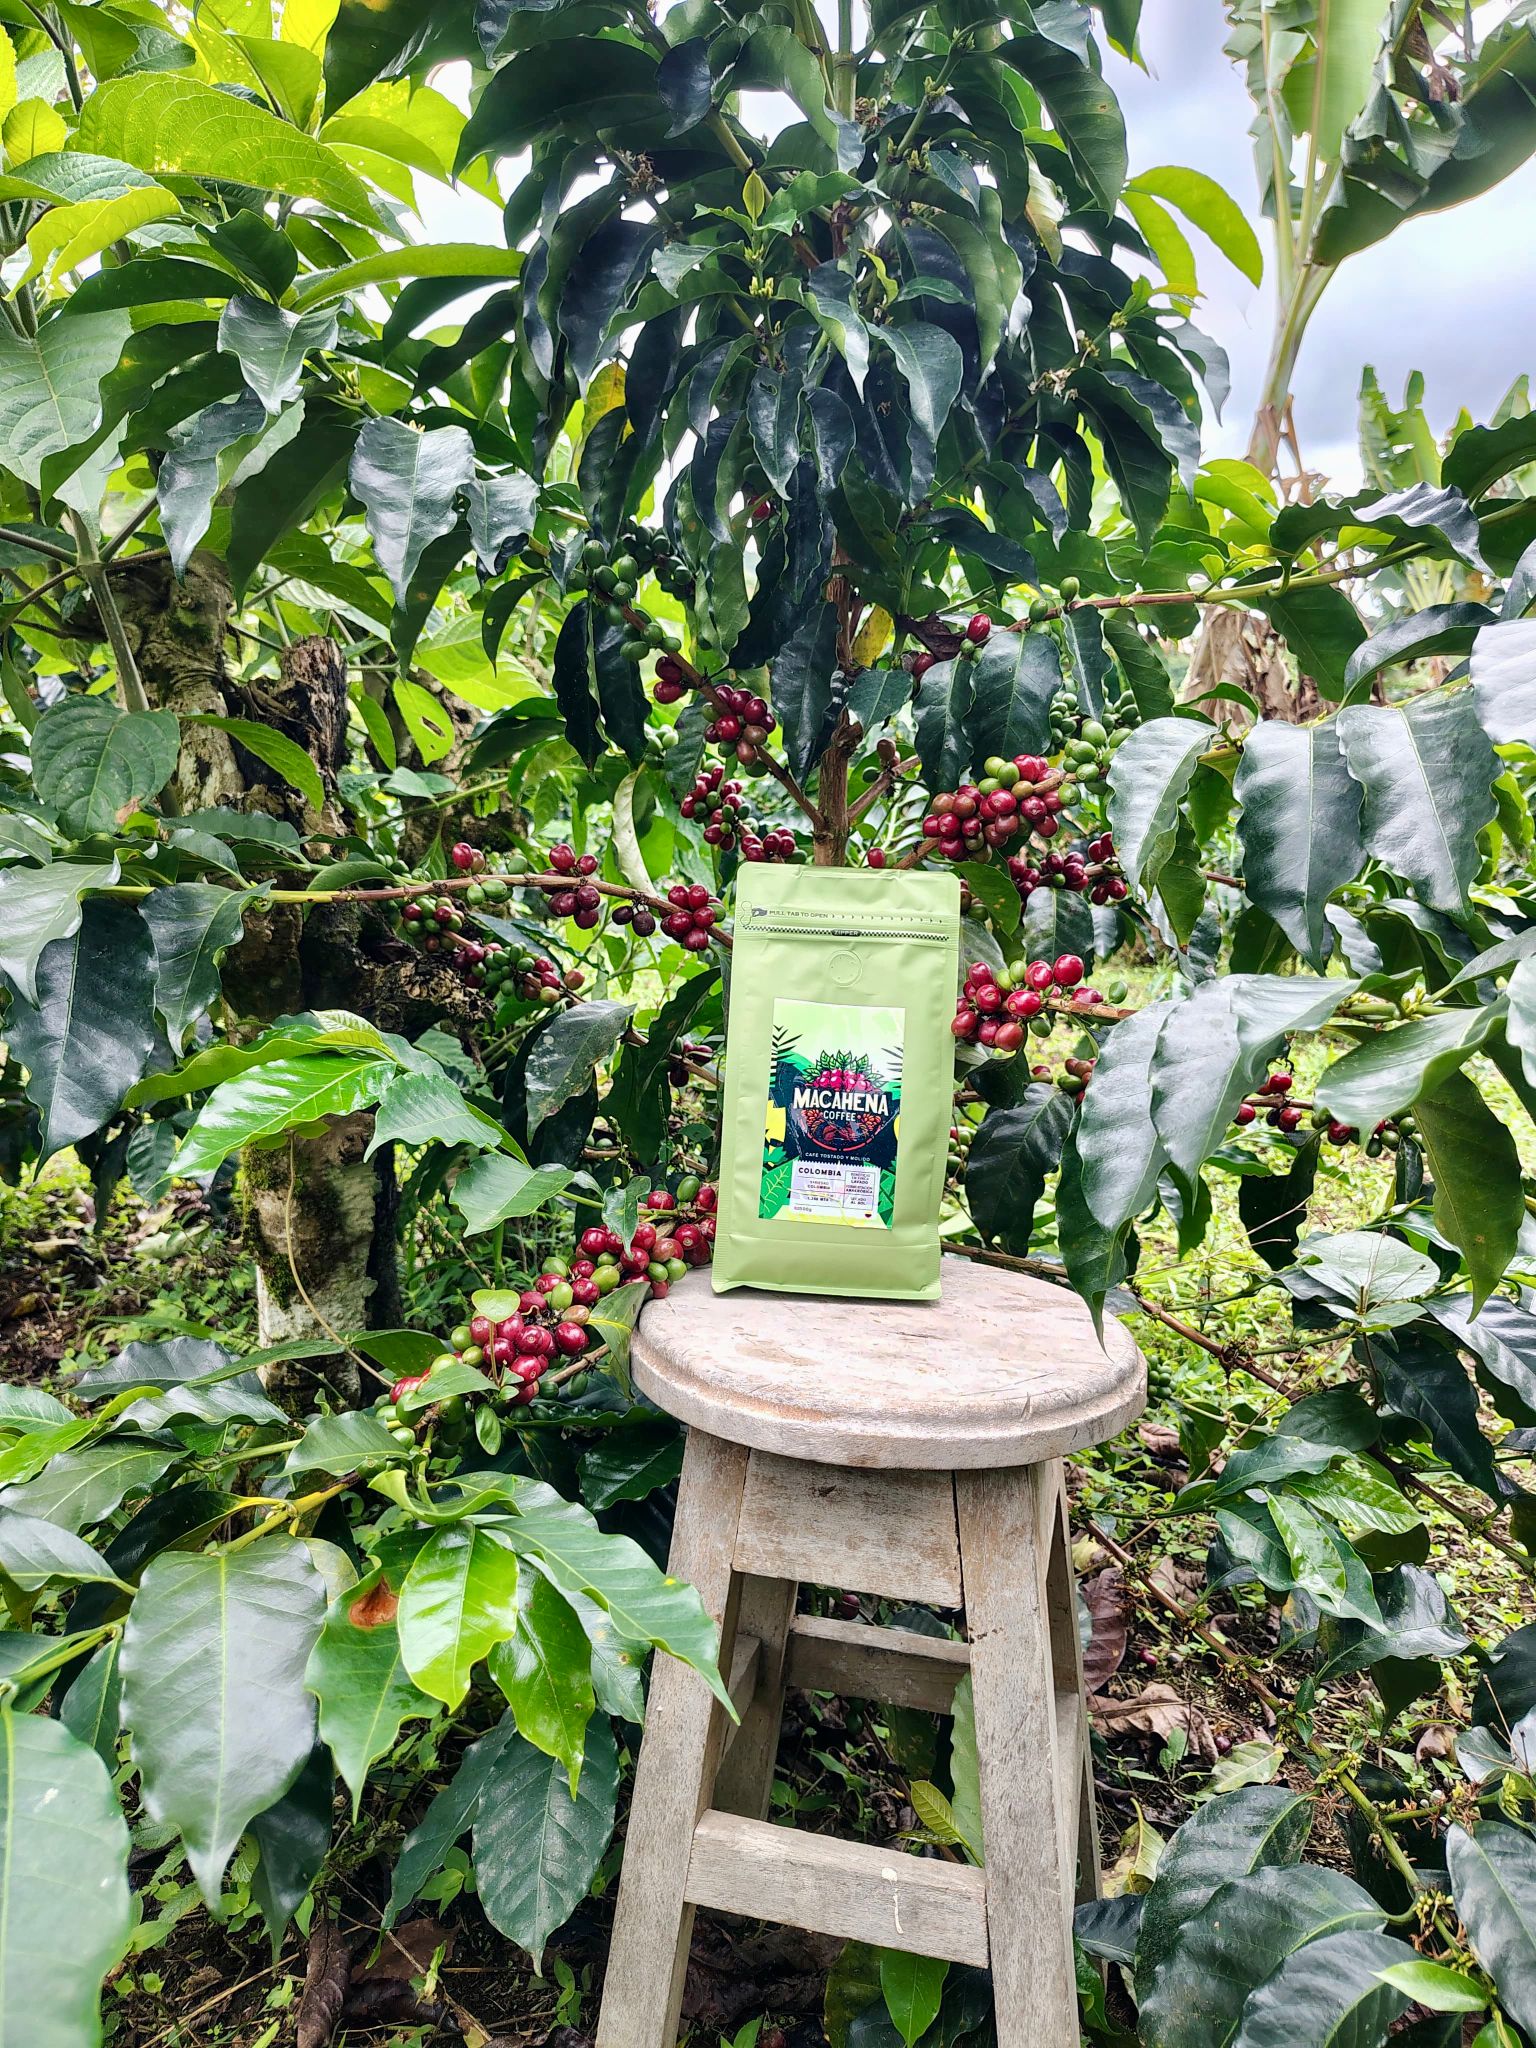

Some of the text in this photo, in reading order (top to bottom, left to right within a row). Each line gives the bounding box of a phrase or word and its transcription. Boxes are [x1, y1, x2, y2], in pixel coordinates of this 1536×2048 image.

[793, 1087, 889, 1117] MACAHENA
[823, 1110, 857, 1122] COFFEE
[798, 1167, 842, 1177] COLOMBIA
